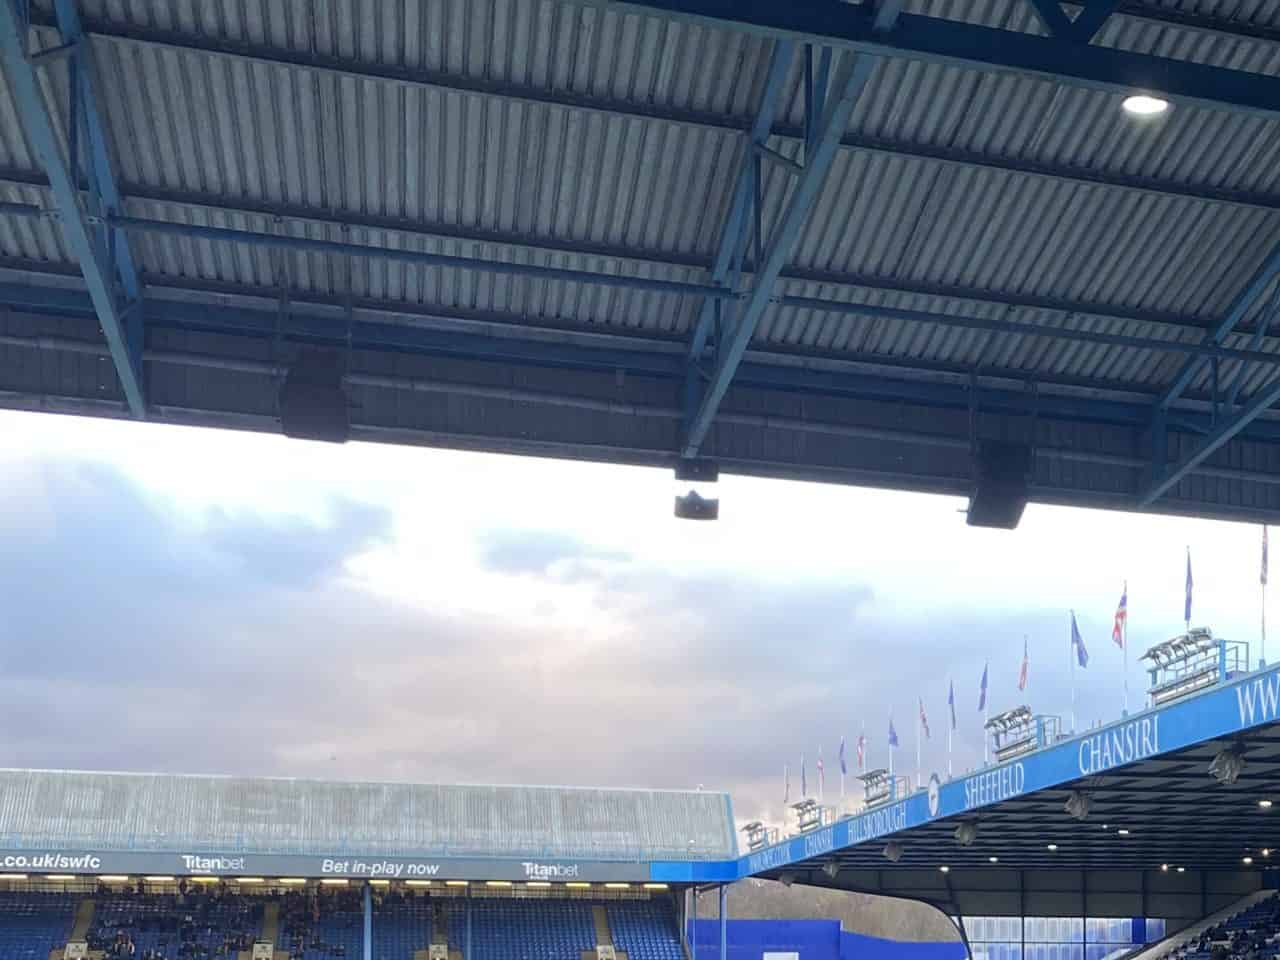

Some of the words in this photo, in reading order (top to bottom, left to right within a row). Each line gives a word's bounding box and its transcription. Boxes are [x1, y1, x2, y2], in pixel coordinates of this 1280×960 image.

[1079, 714, 1160, 775] CHANSIRI
[964, 762, 1025, 809] SHEFFIELD
[182, 855, 247, 869] Titanbet
[321, 859, 349, 873] Bet
[352, 860, 404, 876] in-play
[407, 863, 440, 875] now
[521, 861, 579, 876] Titanbet
